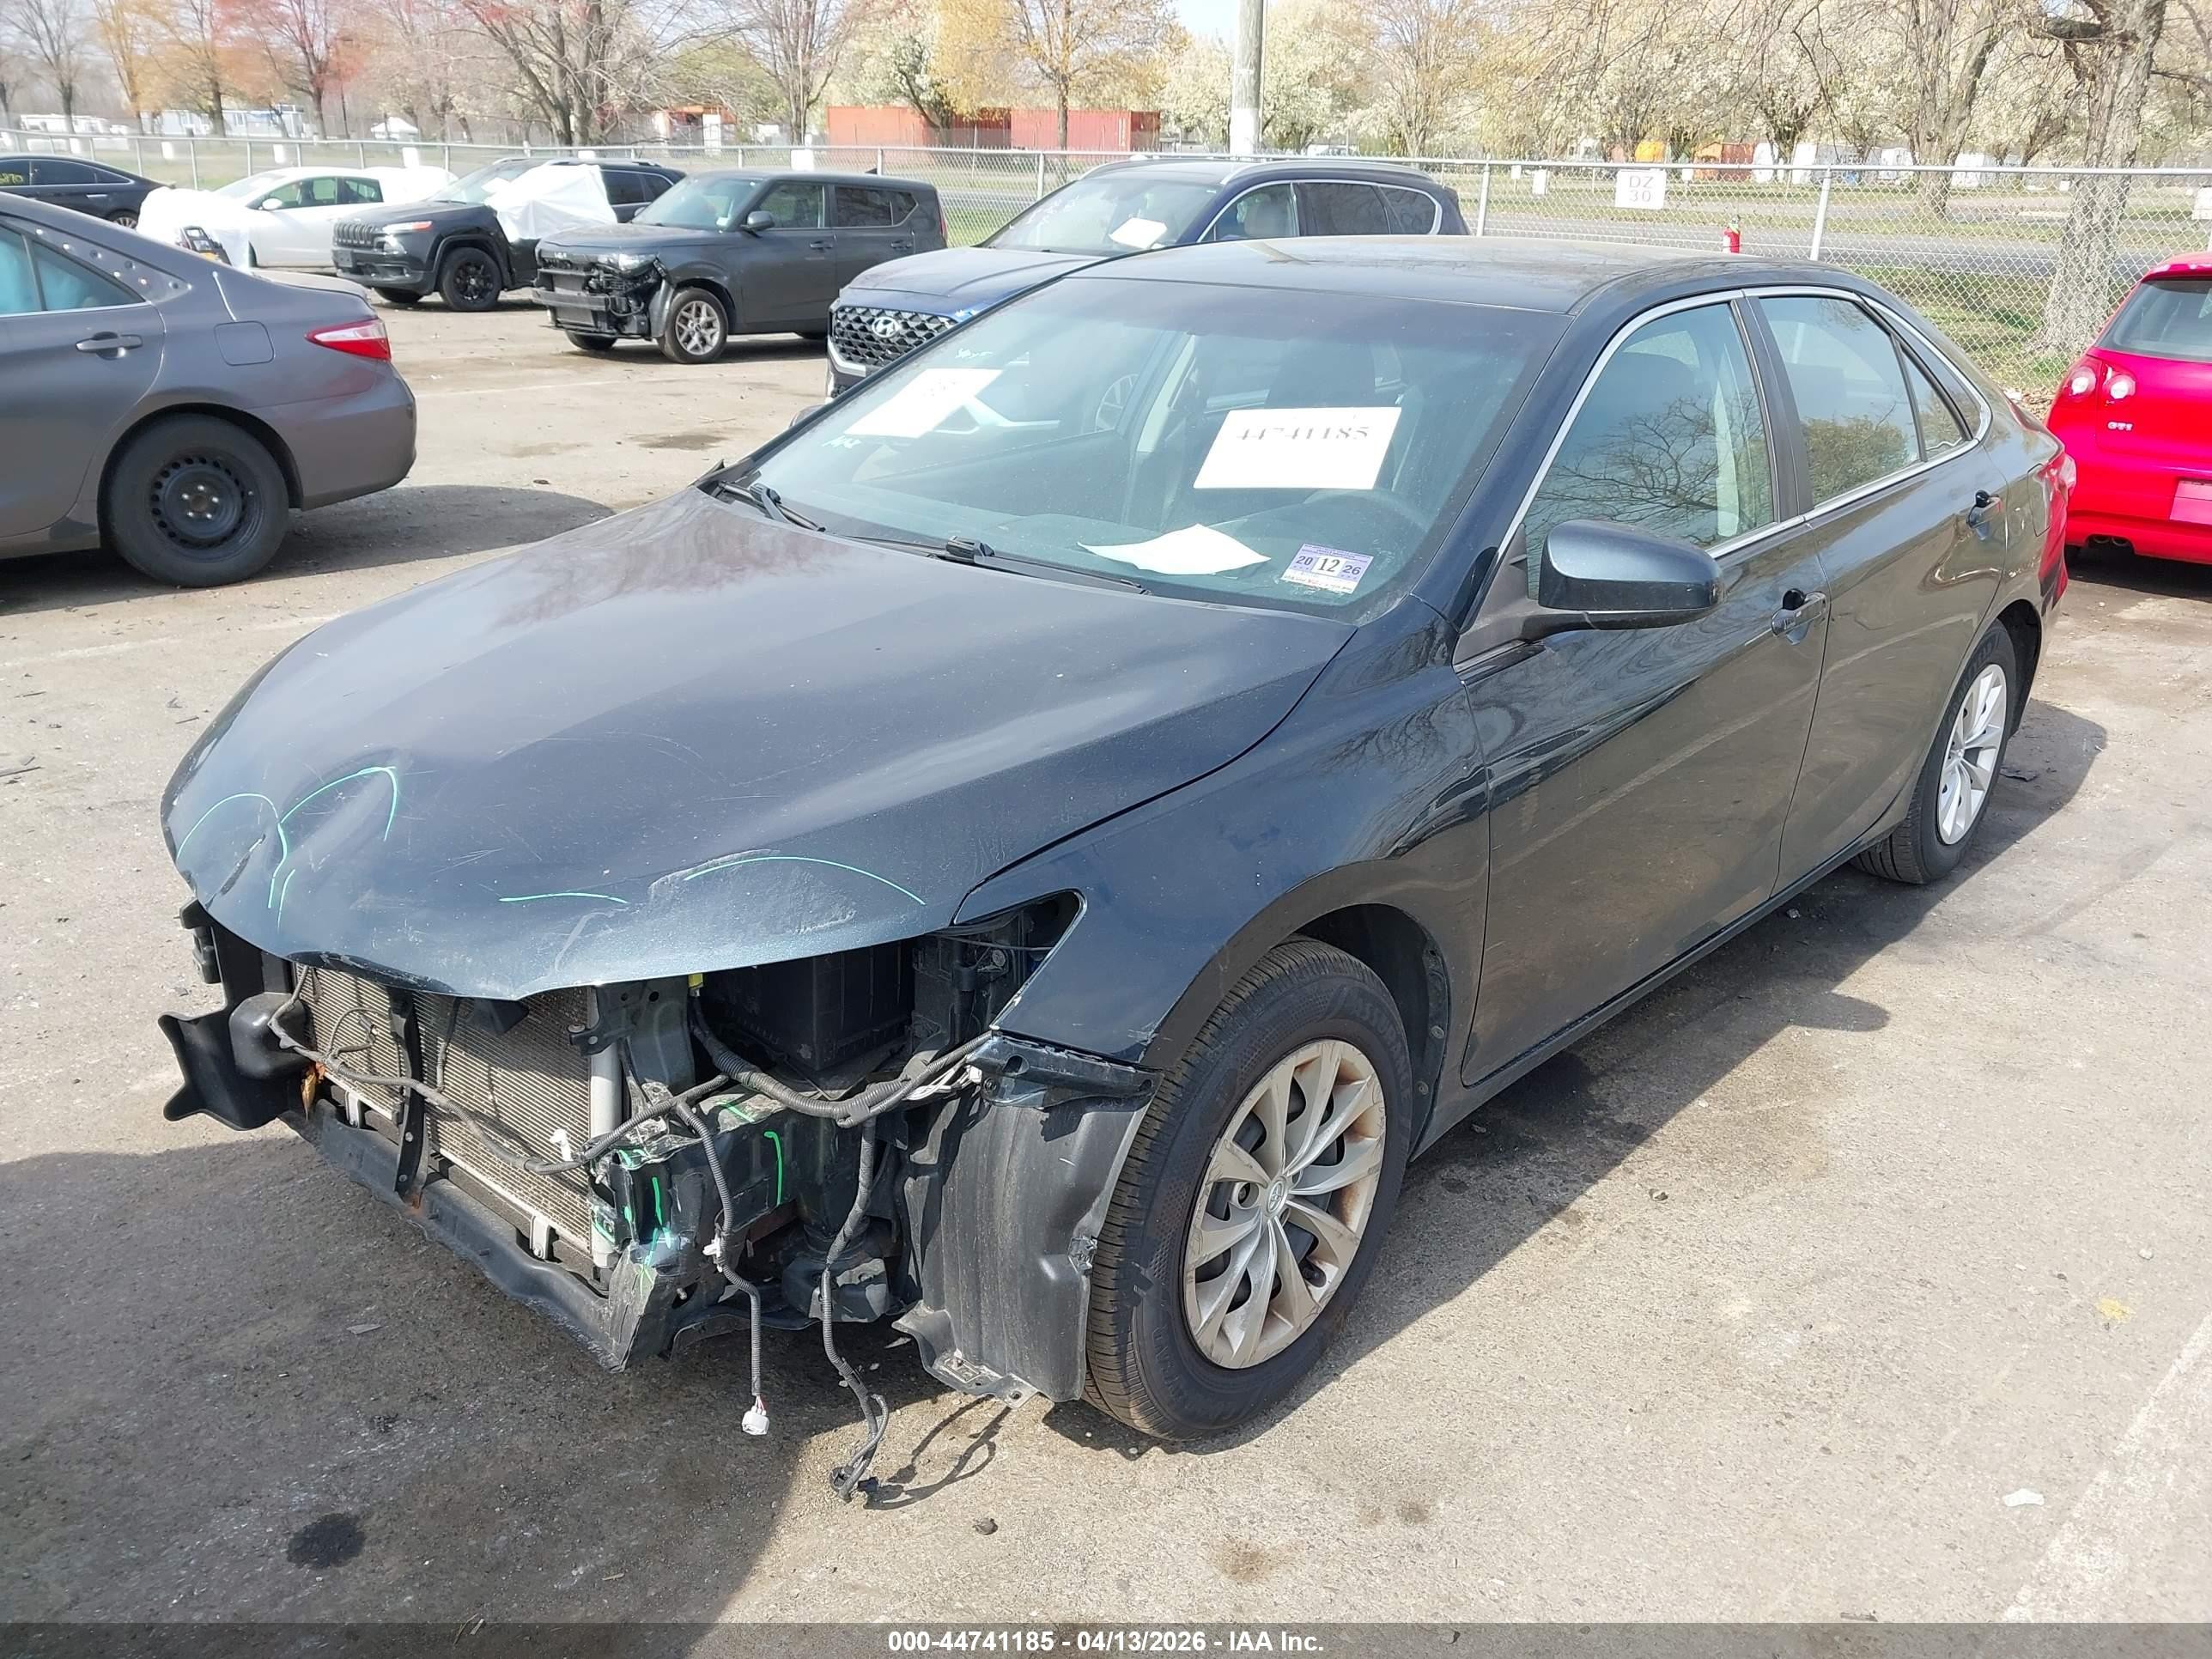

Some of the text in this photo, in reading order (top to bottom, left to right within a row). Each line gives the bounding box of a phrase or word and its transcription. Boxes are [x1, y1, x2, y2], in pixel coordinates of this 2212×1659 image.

[1629, 175, 1654, 188] DZ
[1629, 190, 1651, 203] 30
[1295, 556, 1362, 575] 20 12 26
